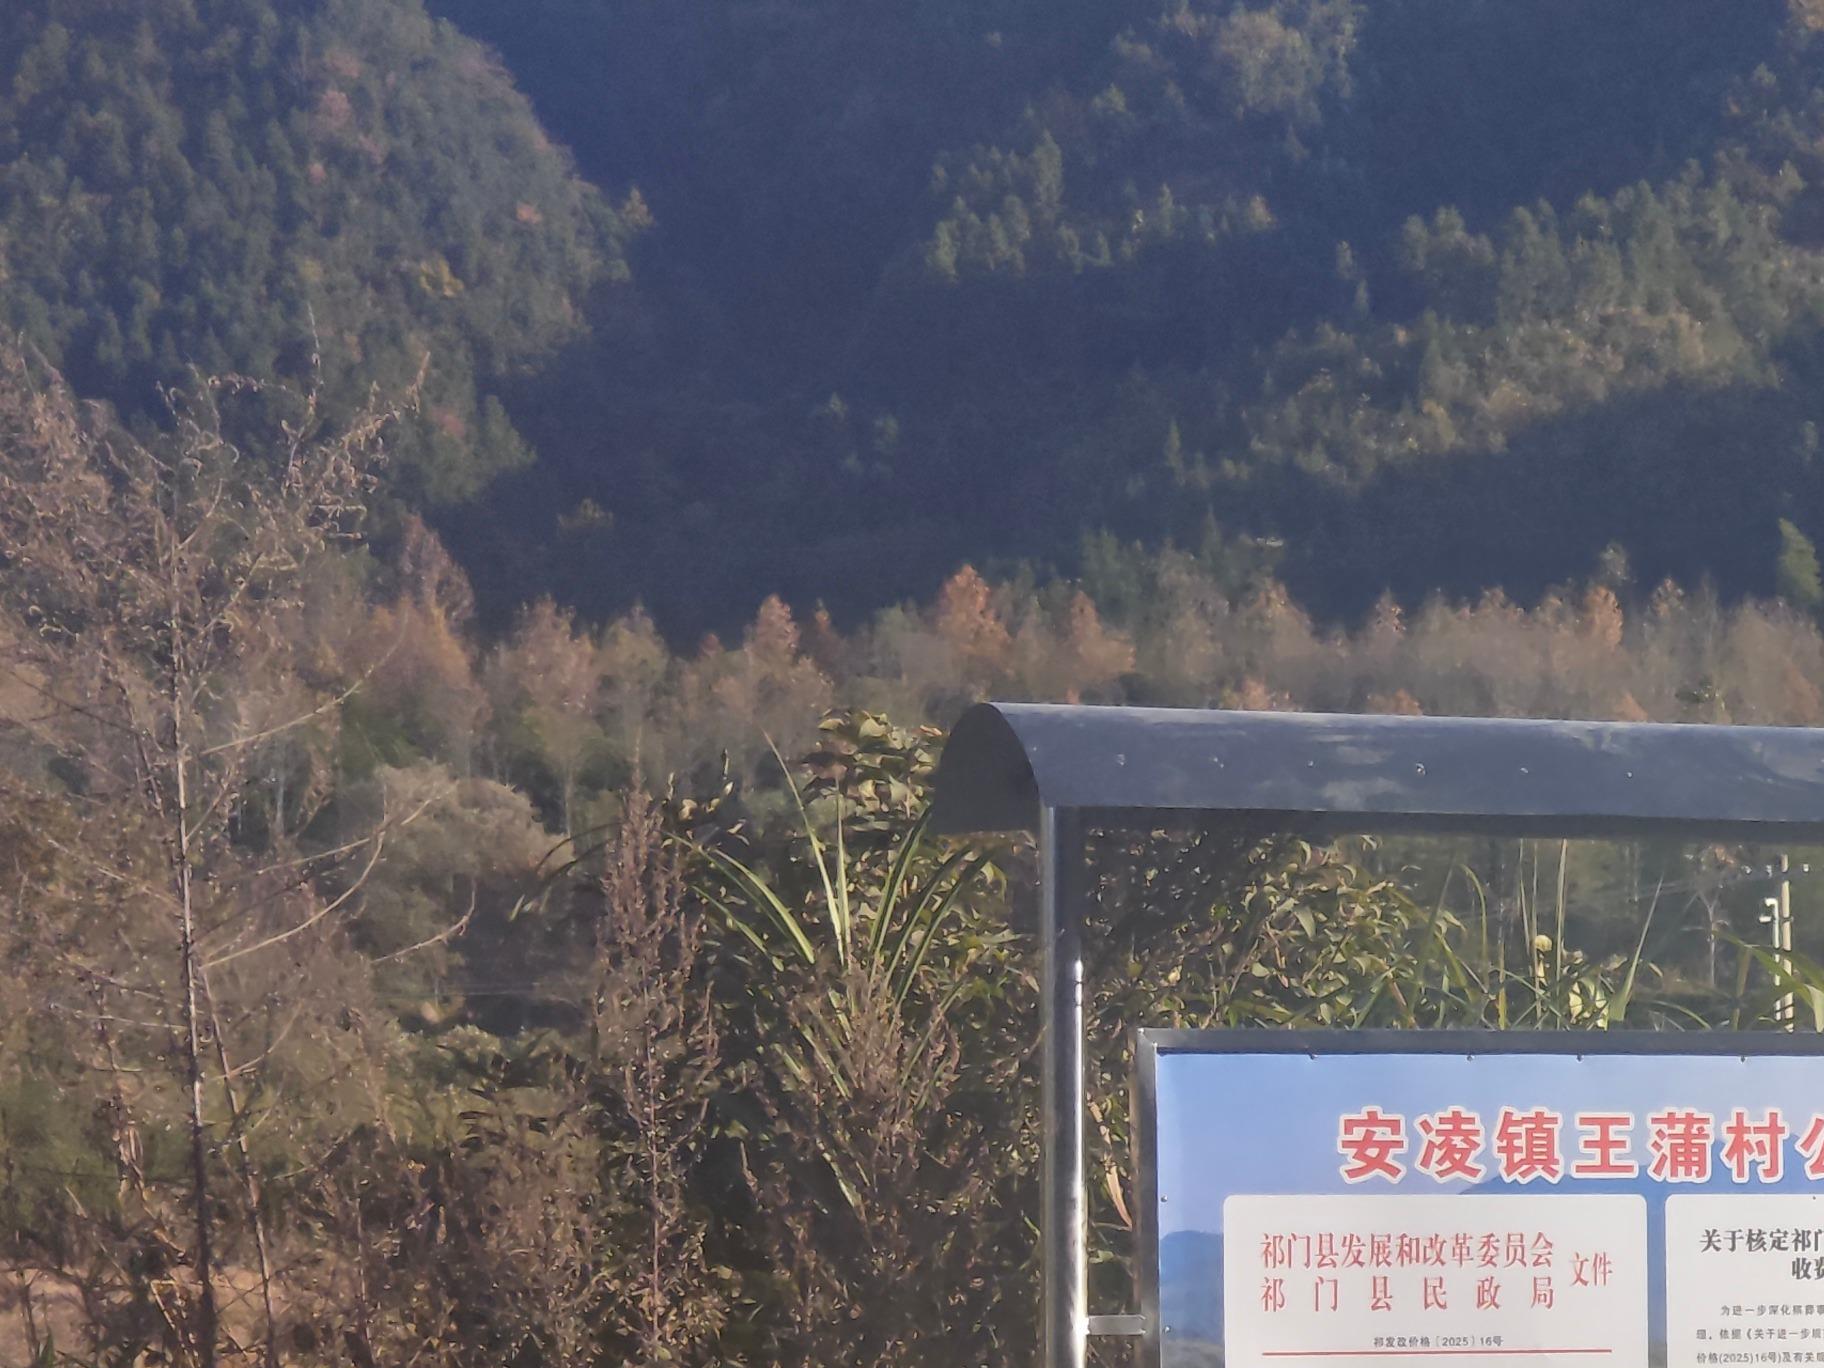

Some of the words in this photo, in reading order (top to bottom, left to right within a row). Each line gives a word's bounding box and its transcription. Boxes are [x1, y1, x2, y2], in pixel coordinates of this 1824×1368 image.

[1260, 1232, 1554, 1269] 祁门县发展和改革委员会
[1569, 1251, 1613, 1288] 文件
